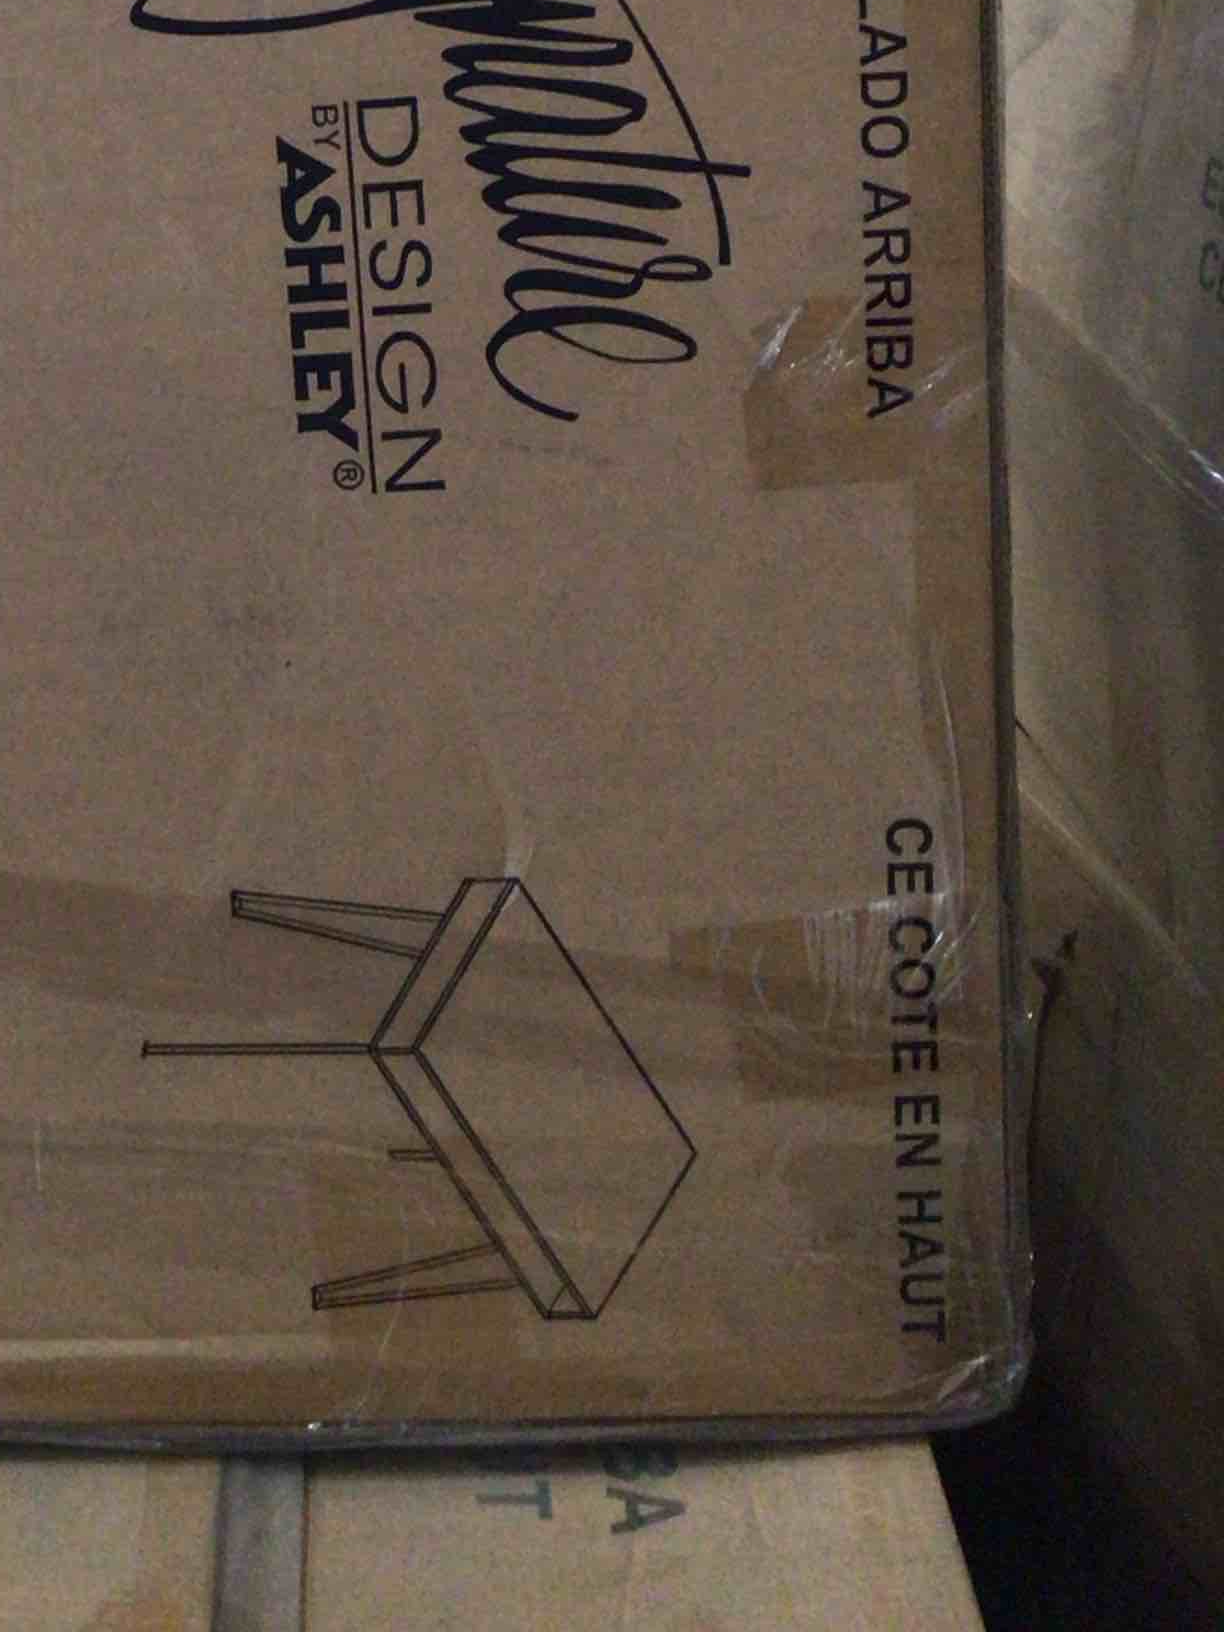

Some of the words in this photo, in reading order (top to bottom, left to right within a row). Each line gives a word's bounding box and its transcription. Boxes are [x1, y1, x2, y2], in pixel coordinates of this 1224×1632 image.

[311, 103, 339, 150] BY
[356, 96, 446, 494] DESIGN
[861, 180, 915, 422] ARRIBA
[883, 817, 934, 898] CE
[886, 913, 941, 1073] COTE
[894, 1095, 942, 1167] EN
[896, 1187, 946, 1342] HAUT
